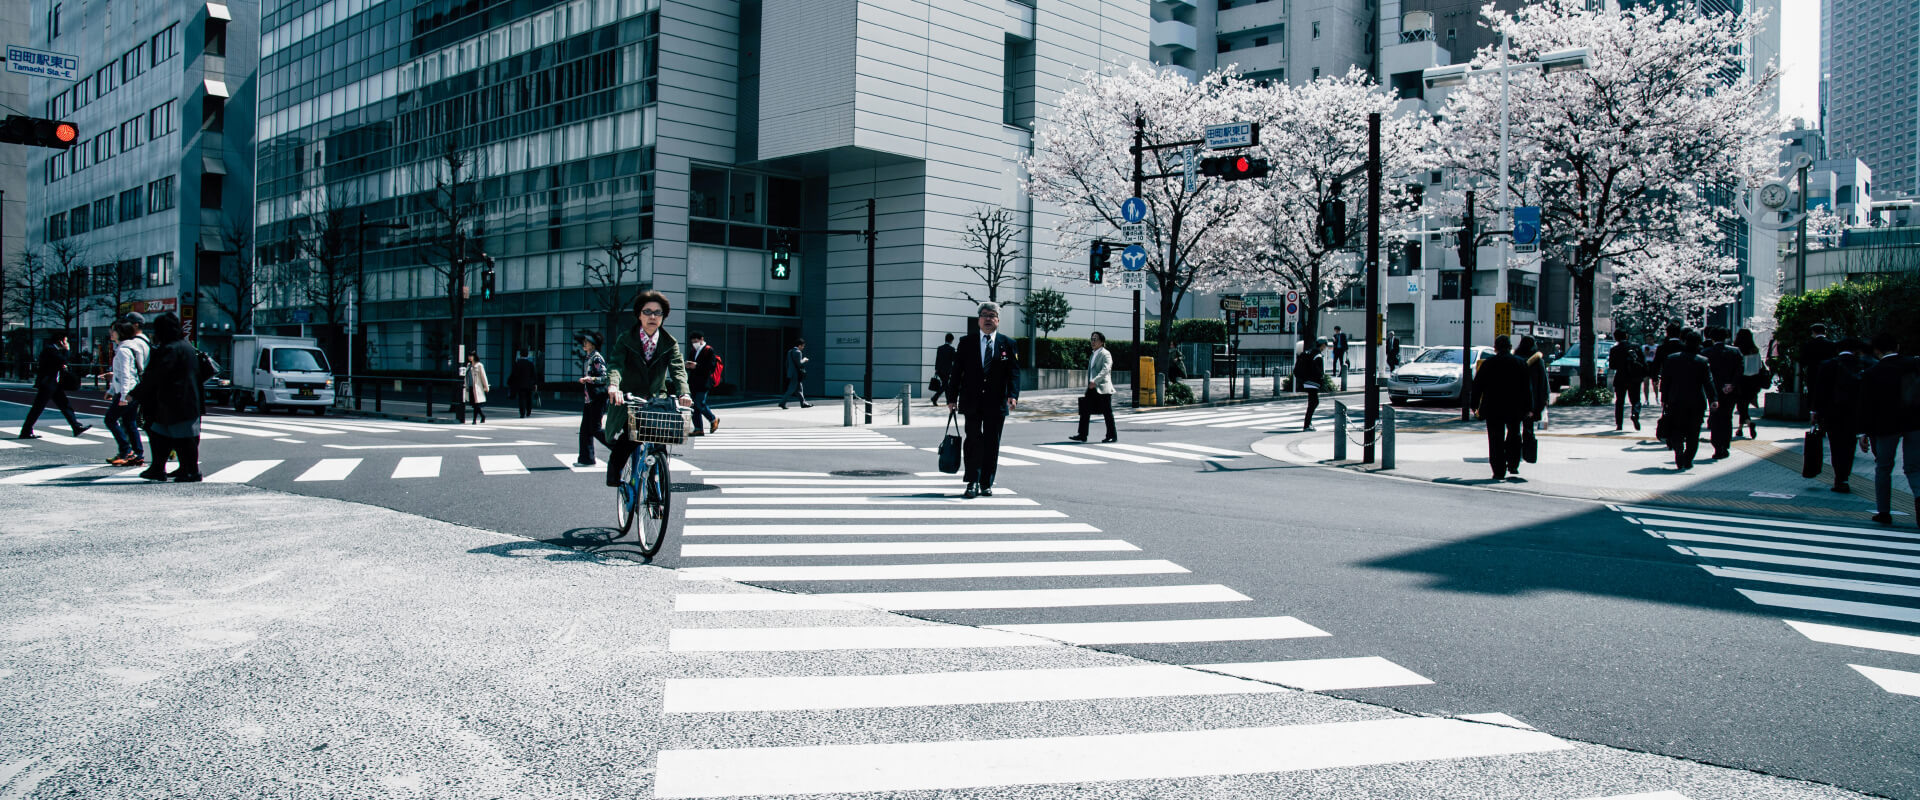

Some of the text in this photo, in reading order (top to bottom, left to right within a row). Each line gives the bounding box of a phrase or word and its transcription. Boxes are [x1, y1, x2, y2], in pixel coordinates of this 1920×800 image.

[9, 49, 76, 70] 田町駅東口
[13, 62, 44, 73] Tamachi
[1207, 125, 1248, 138] 田町駅東口
[1185, 150, 1194, 190] スクランブル式
[1253, 323, 1280, 331] Lepton
